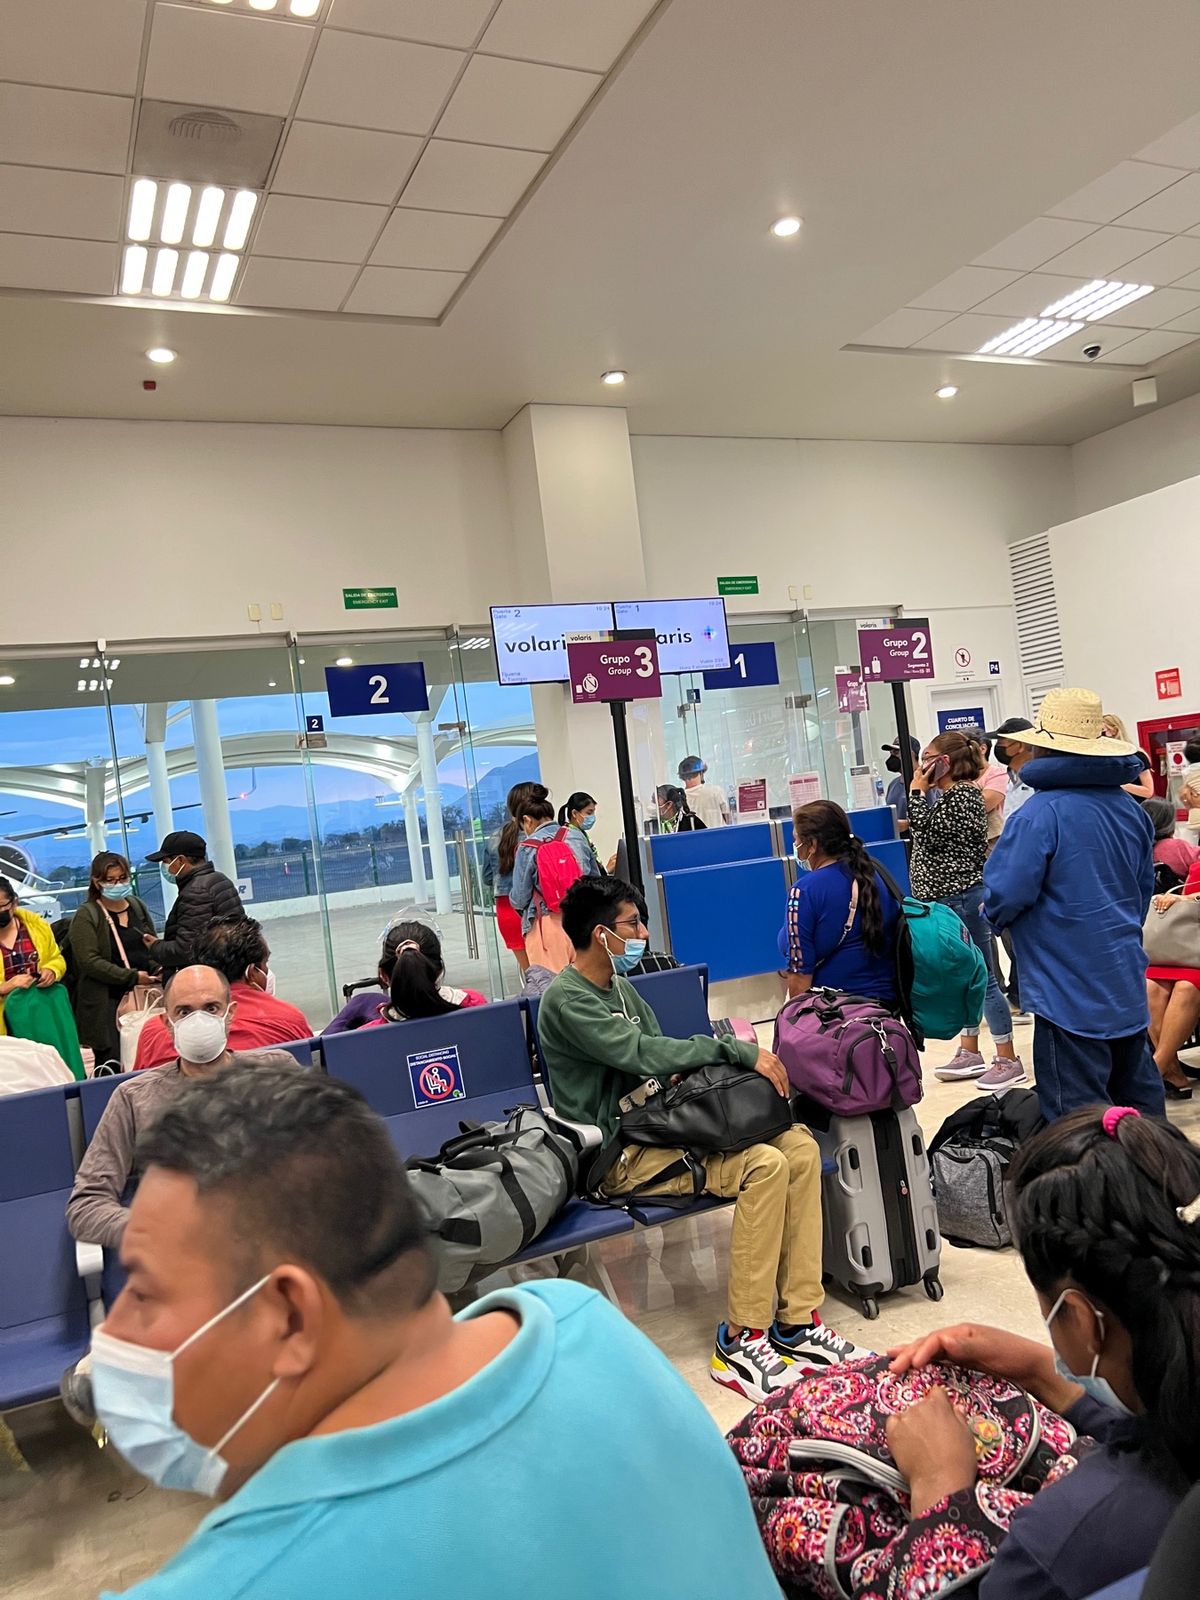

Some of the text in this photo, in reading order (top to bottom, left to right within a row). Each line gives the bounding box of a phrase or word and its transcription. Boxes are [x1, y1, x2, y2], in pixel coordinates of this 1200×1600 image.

[514, 609, 521, 618] 2
[504, 635, 567, 653] volari
[656, 628, 692, 645] aris
[883, 632, 928, 659] Grupo 2
[890, 650, 909, 658] Group
[600, 646, 654, 678] Grupo 3
[734, 653, 747, 678] 1
[608, 667, 632, 676] Group
[368, 674, 390, 704] 2
[311, 719, 319, 728] 2
